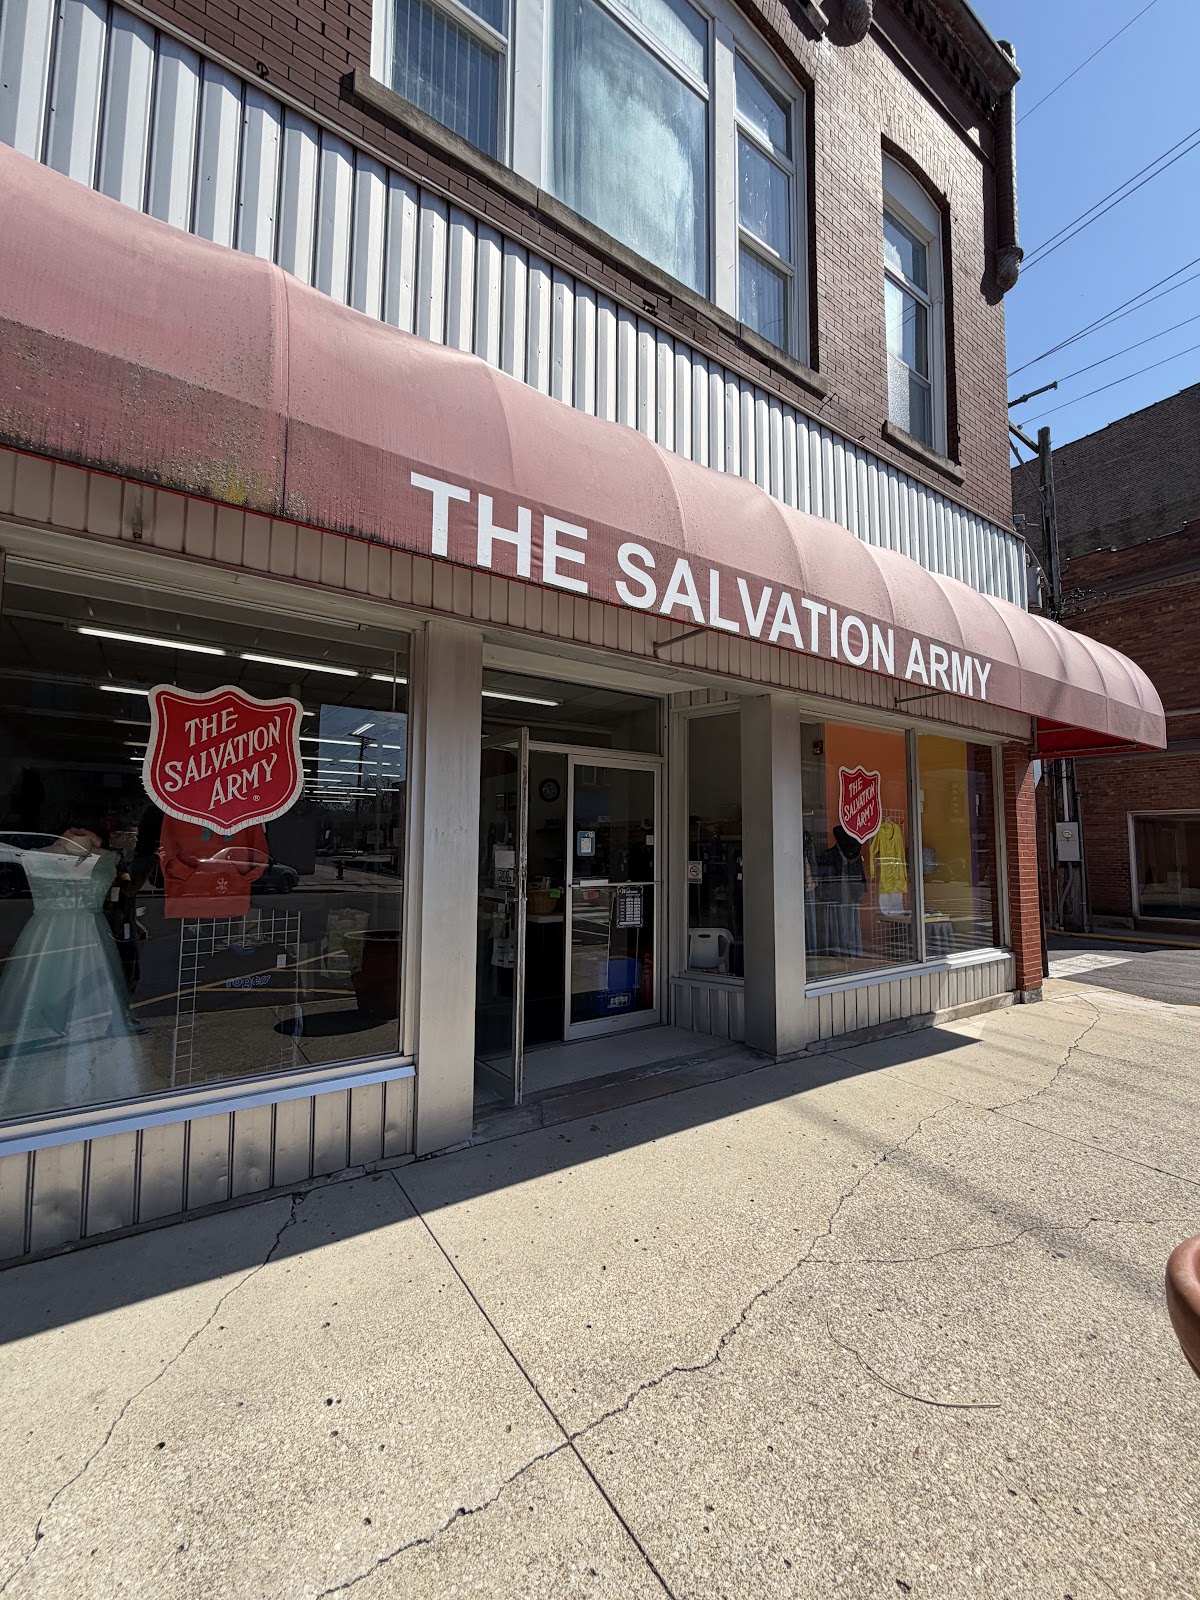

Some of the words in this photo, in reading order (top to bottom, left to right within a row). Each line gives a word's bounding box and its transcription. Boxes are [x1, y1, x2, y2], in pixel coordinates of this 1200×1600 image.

[410, 472, 588, 593] THE
[616, 542, 894, 675] SALVATION
[904, 637, 992, 700] ARMY
[184, 707, 238, 747] THE
[164, 716, 281, 792] SALVATION
[208, 753, 278, 811] ARMY
[844, 781, 875, 821] SALVATION
[848, 777, 863, 798] THE
[856, 800, 875, 831] ARMY
